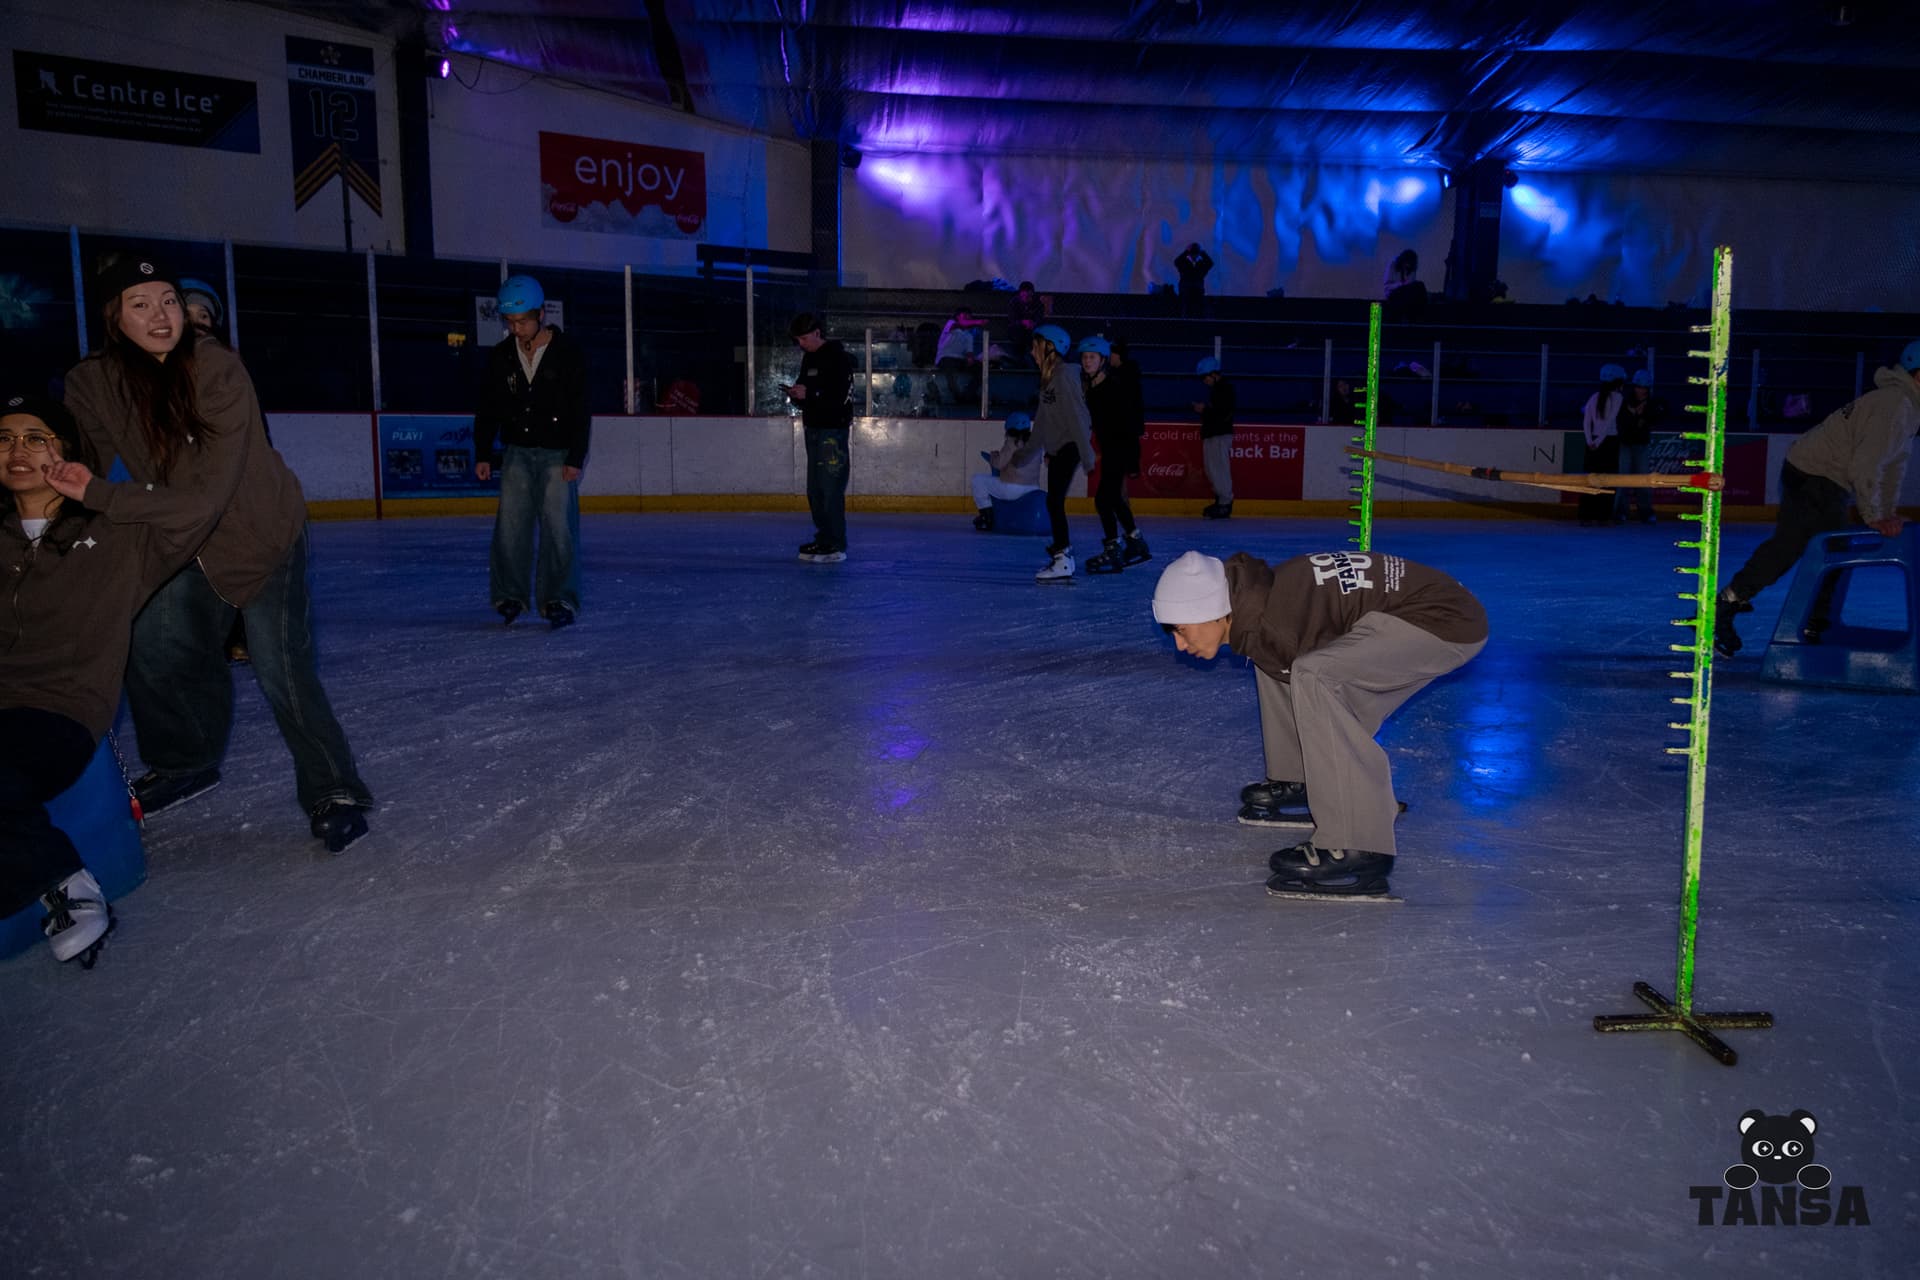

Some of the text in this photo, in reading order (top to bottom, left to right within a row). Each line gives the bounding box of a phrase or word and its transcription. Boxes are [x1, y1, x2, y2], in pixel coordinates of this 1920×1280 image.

[298, 67, 365, 86] CHAMBERLAIN
[72, 73, 214, 113] Centre Ice
[309, 87, 360, 142] 12
[575, 151, 685, 200] enjoy
[1152, 430, 1179, 441] cold
[1263, 432, 1275, 442] at
[1279, 432, 1299, 443] the
[1269, 445, 1299, 459] Bar
